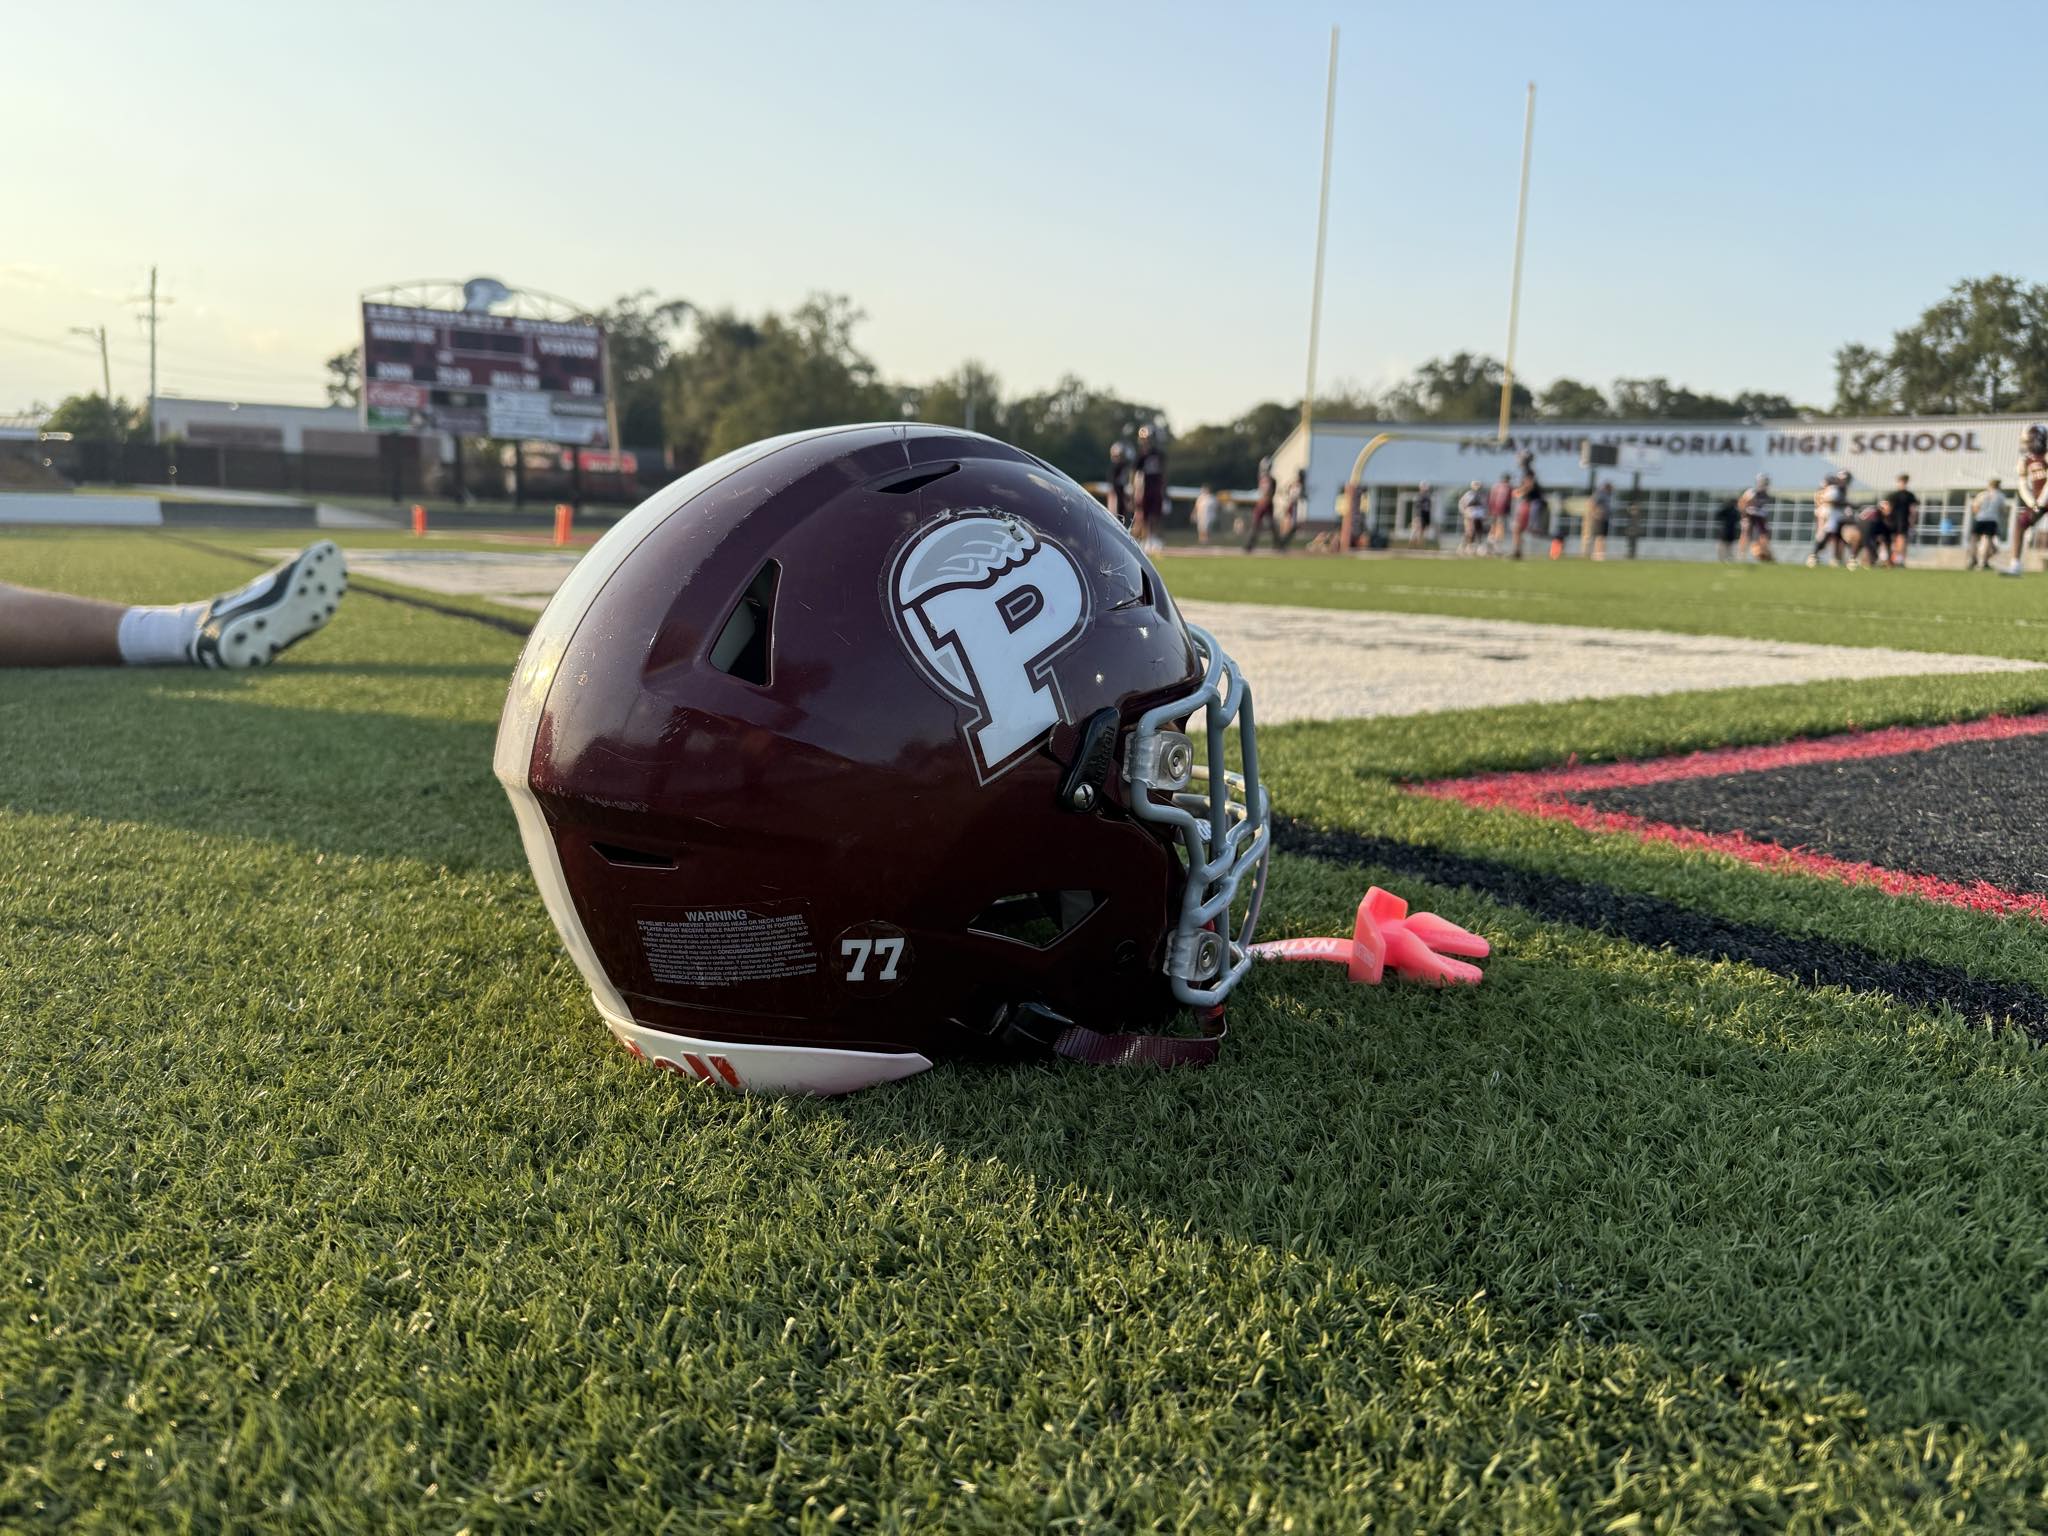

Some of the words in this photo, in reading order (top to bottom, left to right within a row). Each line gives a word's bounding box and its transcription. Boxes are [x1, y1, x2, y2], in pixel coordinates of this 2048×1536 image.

[1768, 433, 1840, 454] HIGH
[1851, 432, 1982, 454] SCHOOL
[917, 539, 1084, 770] P
[685, 910, 748, 922] WARNING
[841, 937, 905, 981] 77
